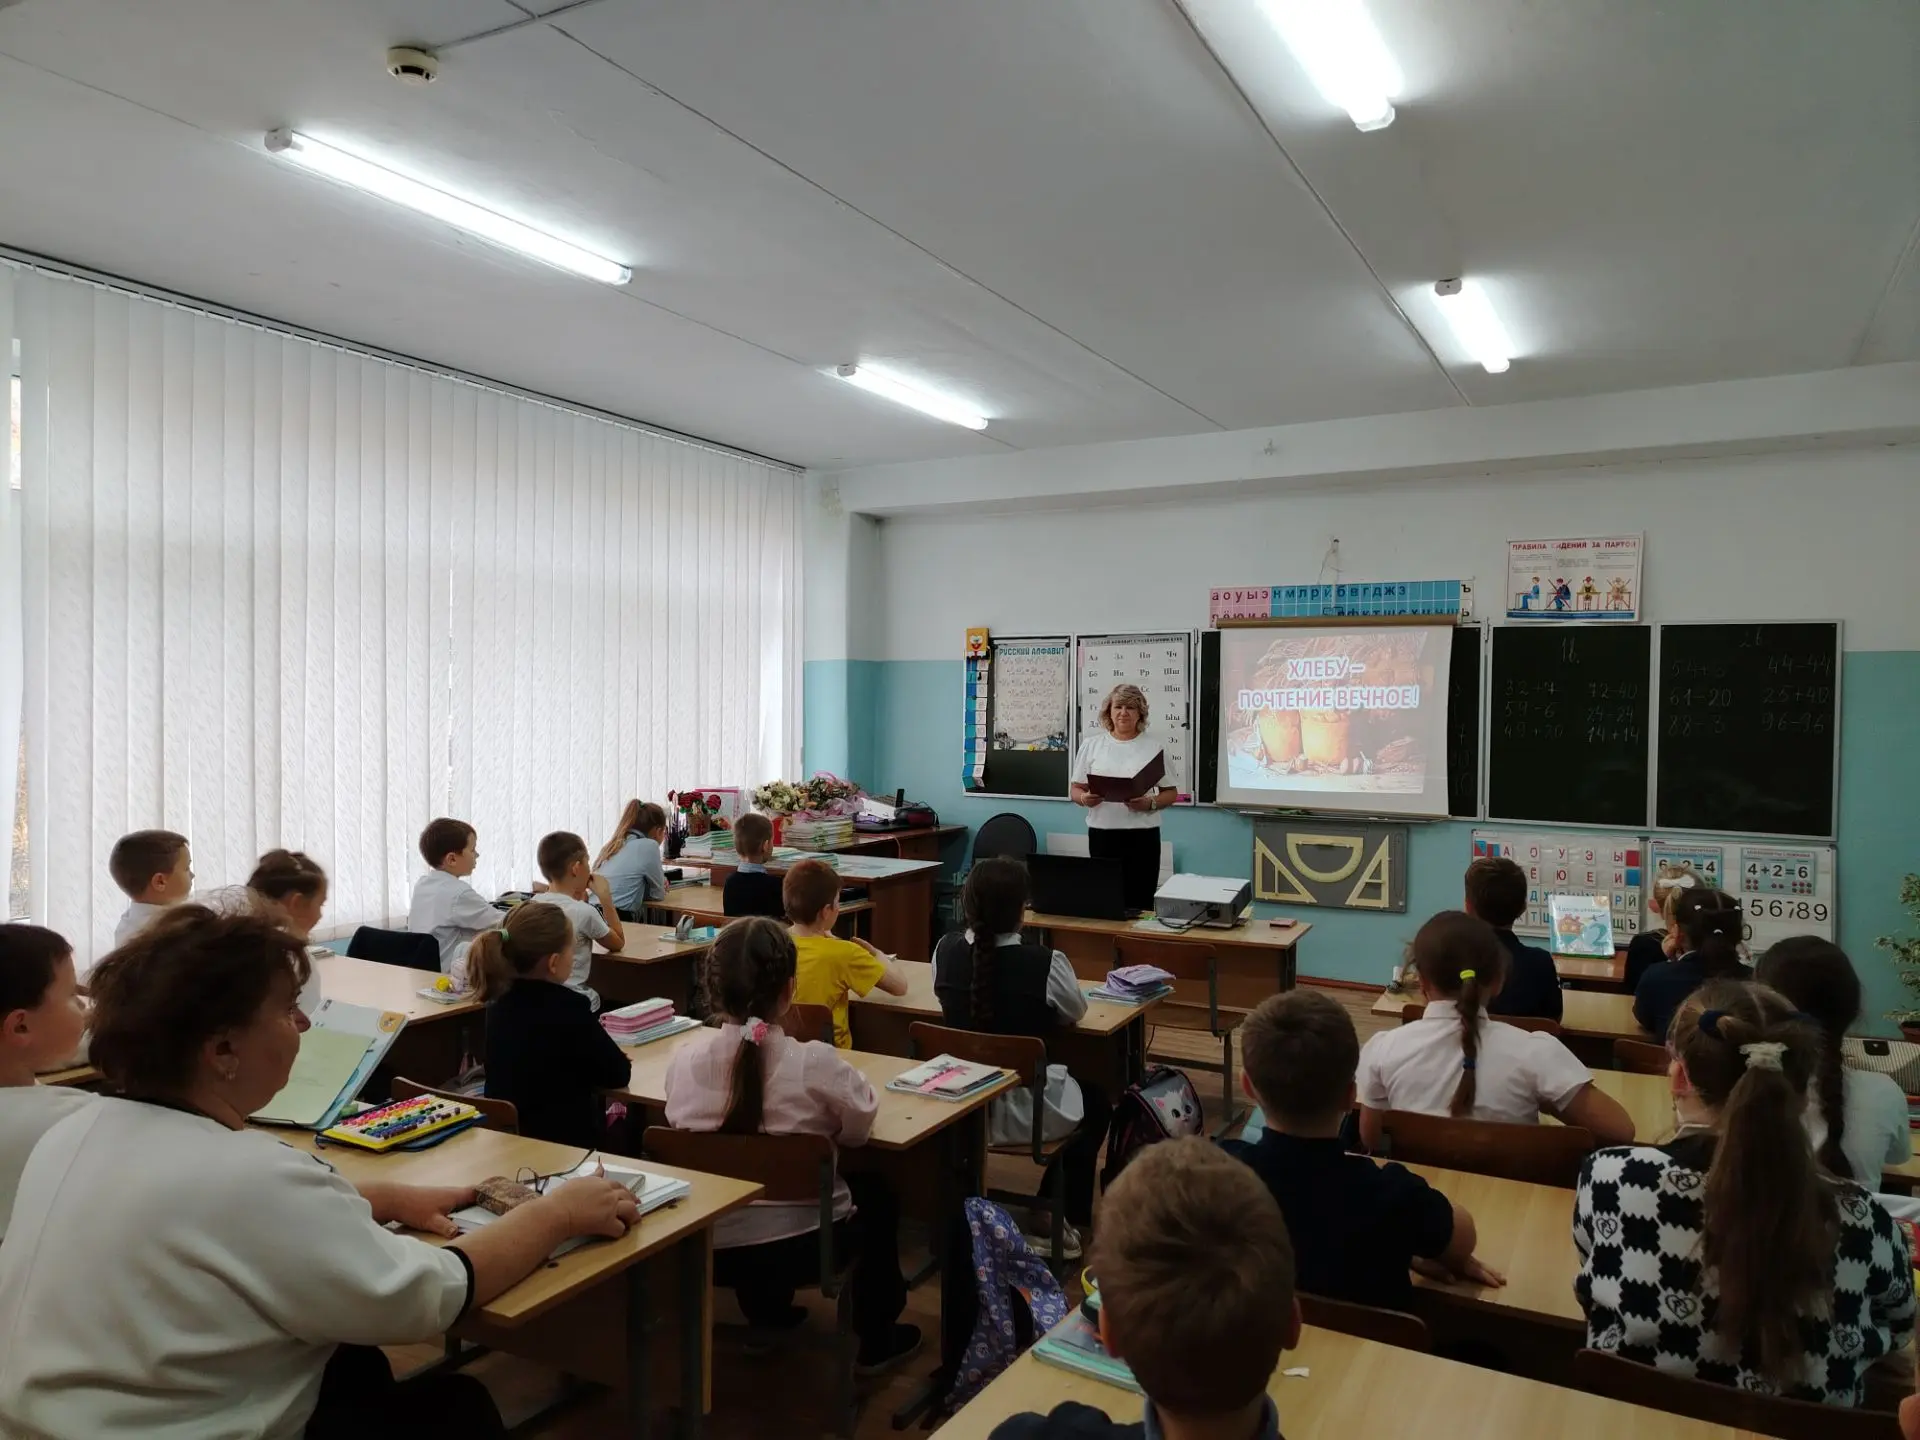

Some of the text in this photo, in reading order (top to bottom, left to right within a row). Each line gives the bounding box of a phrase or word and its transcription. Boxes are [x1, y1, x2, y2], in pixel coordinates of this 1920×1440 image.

[1512, 543, 1547, 551] ПРАВИЛА
[1032, 647, 1065, 656] АЛФАВИТ
[1288, 659, 1347, 678] ХЛЕБУ
[1239, 687, 1419, 709] ПОЧТЕНИЕ ВЕЧНОЕ!
[1503, 848, 1511, 856] А
[1558, 849, 1565, 859] У
[1613, 851, 1623, 862] Ы
[1530, 866, 1622, 883] Ё Ю Е И
[1530, 891, 1538, 901] Д
[1615, 895, 1622, 906] Р
[1530, 911, 1537, 920] Т
